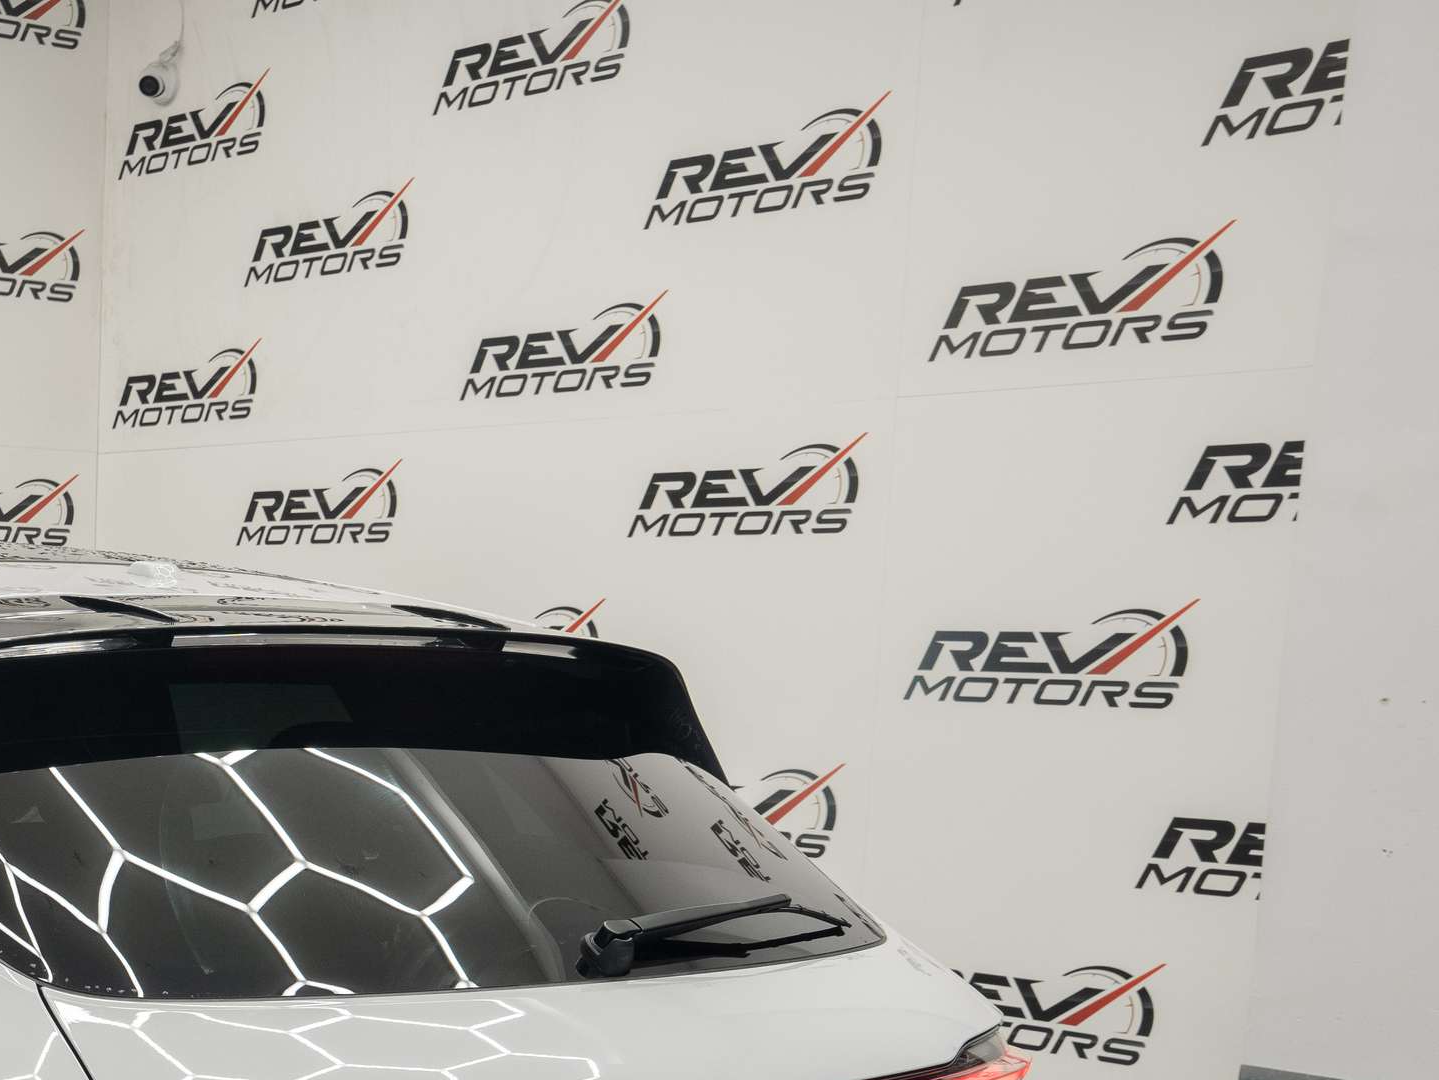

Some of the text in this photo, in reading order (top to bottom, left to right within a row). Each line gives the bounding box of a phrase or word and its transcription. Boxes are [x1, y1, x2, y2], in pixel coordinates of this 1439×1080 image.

[442, 18, 595, 87] REV
[433, 54, 625, 115] MOTORS
[125, 101, 240, 156] REV
[117, 132, 262, 180] MOTORS
[655, 132, 839, 200] REV
[644, 172, 875, 230] MOTORS
[252, 210, 378, 263] REV
[244, 244, 404, 287] MOTORS
[943, 263, 1170, 330] REV
[470, 324, 625, 374] REV
[928, 310, 1214, 362] MOTORS
[119, 366, 230, 407] REV
[460, 363, 655, 401] MOTORS
[112, 399, 253, 429] MOTORS
[244, 487, 368, 523] REV
[639, 466, 817, 511] REV
[236, 522, 392, 547] MOTORS
[627, 509, 852, 538] MOTORS
[918, 631, 1138, 675] REV
[904, 676, 1180, 710] MOTORS
[951, 968, 1106, 1023] EV
